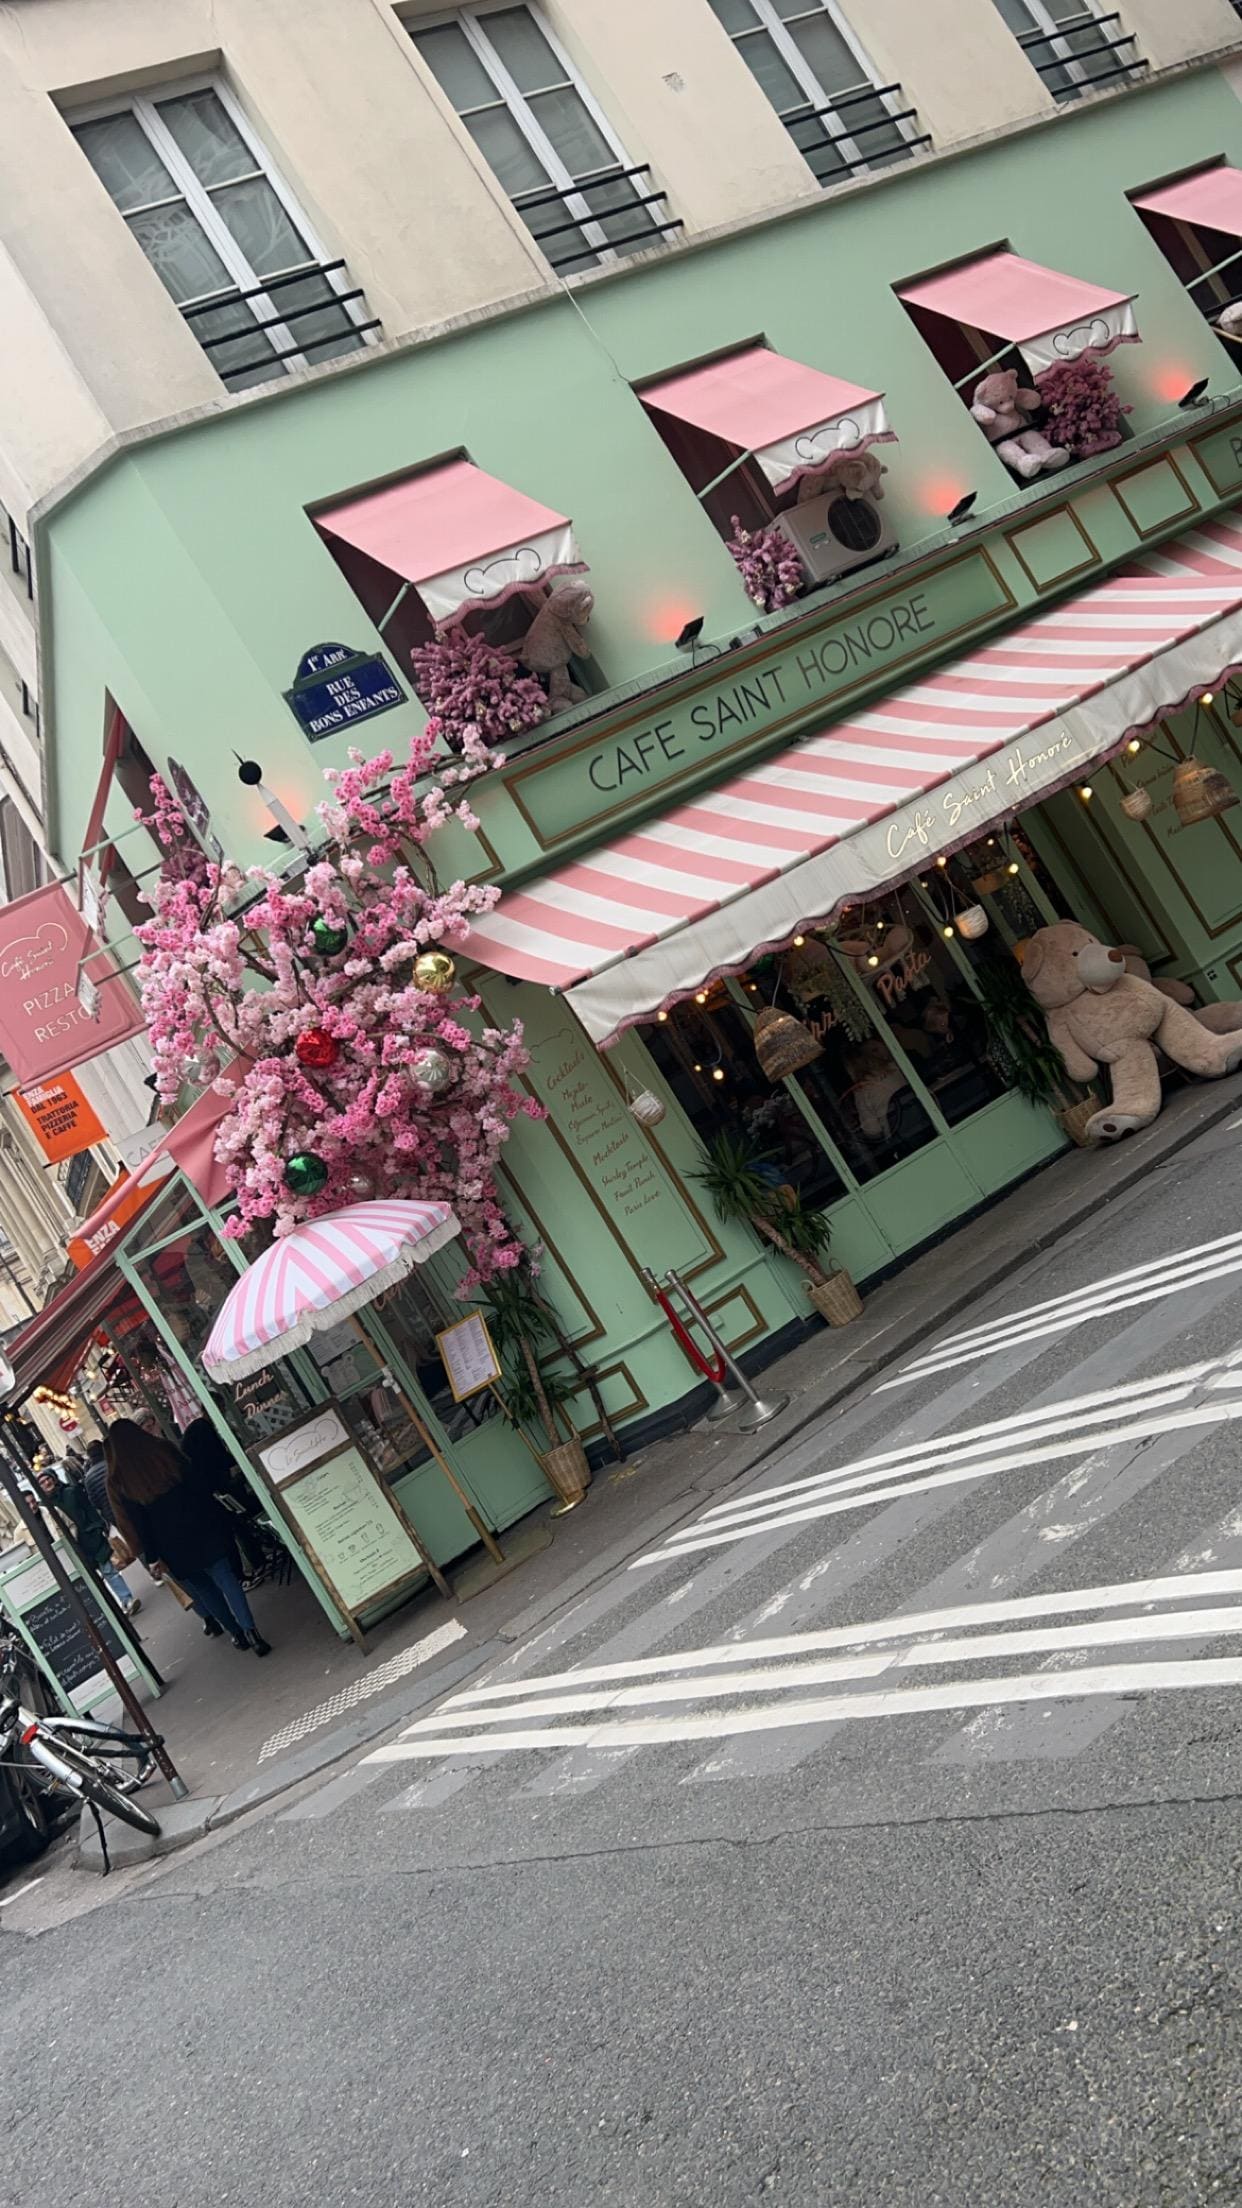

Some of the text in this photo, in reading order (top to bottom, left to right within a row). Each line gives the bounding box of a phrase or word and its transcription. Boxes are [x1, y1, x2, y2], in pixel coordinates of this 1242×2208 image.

[326, 676, 355, 695] RUE
[333, 687, 361, 707] DES
[589, 594, 935, 791] CAFE SAINT HONORE
[309, 686, 398, 733] BONS ENFANTS
[887, 809, 936, 858] Café
[943, 769, 997, 826] Saint
[1006, 732, 1072, 786] Honoré
[877, 951, 932, 1004] Pasta
[23, 982, 75, 1016] PIZZA
[34, 1005, 92, 1043] RESTO
[547, 1050, 584, 1090] Cocktails
[37, 1101, 79, 1124] TRATTORIA
[41, 1111, 78, 1131] PIZZERIA
[593, 1132, 629, 1166] Mocktails
[234, 1369, 274, 1402] Lunch
